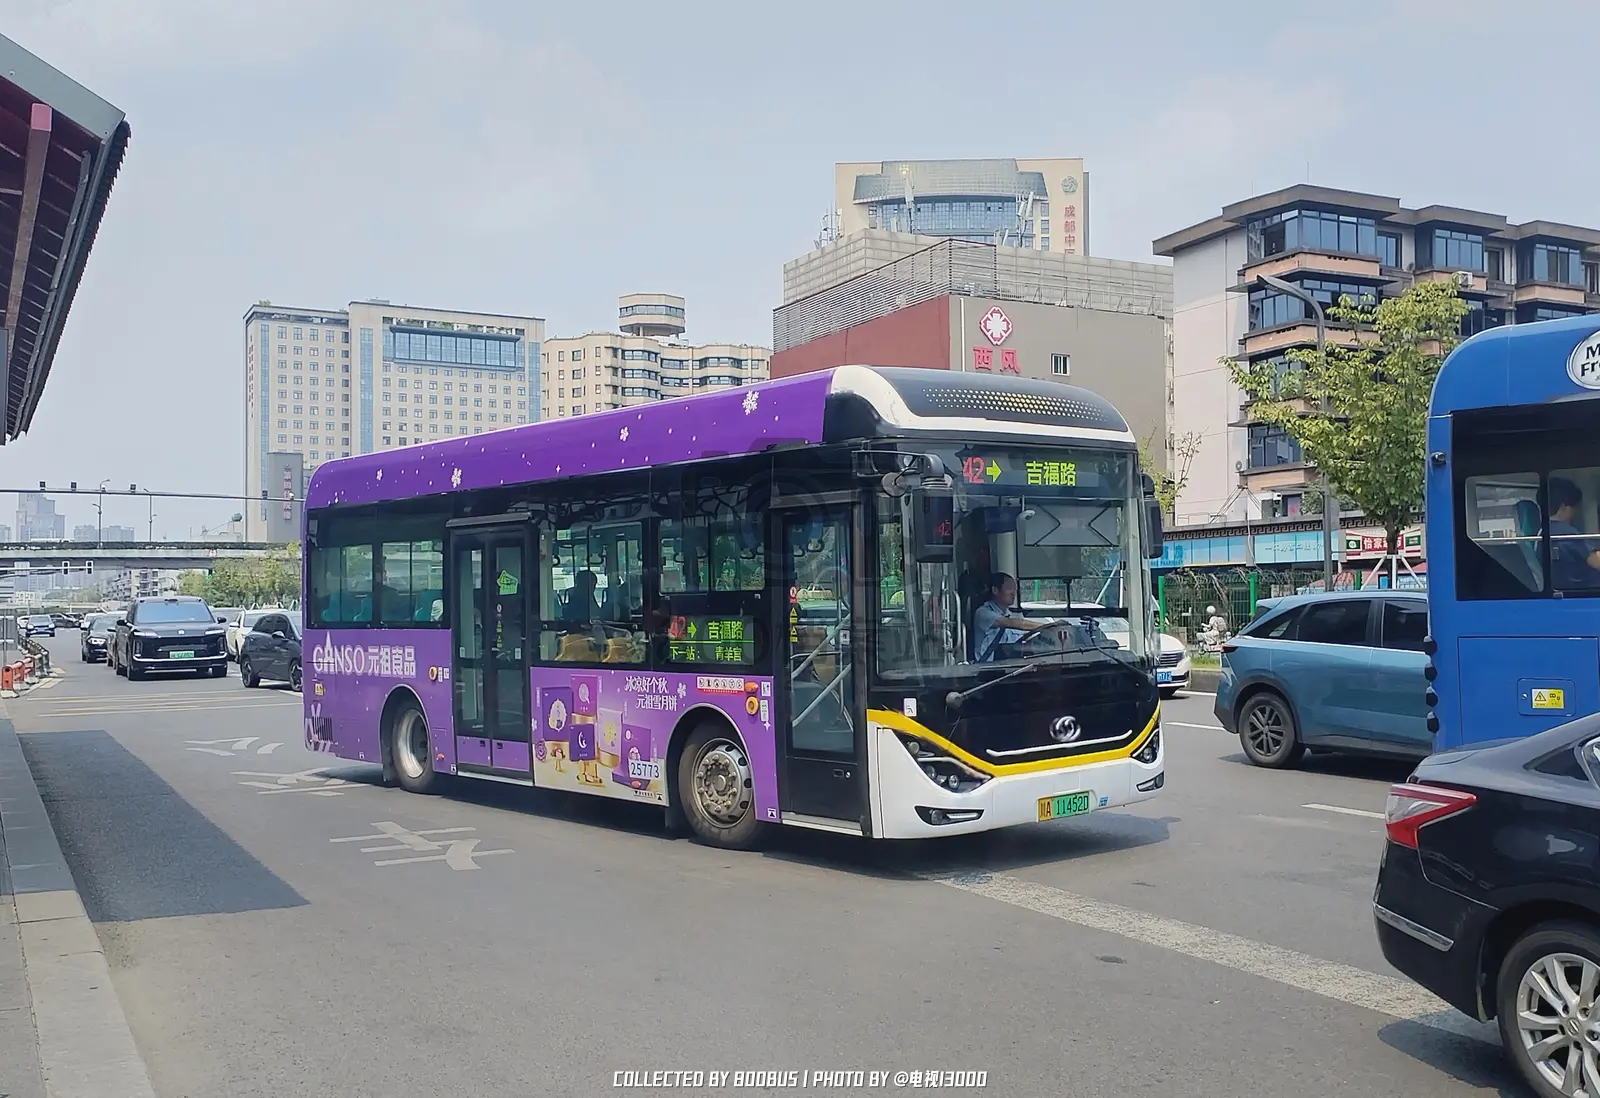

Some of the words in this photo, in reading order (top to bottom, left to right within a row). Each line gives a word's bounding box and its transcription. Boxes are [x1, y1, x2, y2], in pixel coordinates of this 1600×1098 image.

[1581, 360, 1600, 377] Fr
[963, 457, 985, 484] 42
[1025, 461, 1076, 486] 吉福路
[938, 520, 951, 536] 42
[668, 616, 686, 640] 42
[707, 621, 743, 640] 吉福路
[313, 630, 365, 676] GANSO
[368, 646, 416, 678] 元祖食品
[624, 676, 669, 694] 冰凉好个秋
[635, 694, 678, 712] 元祖雪月饼
[631, 762, 660, 779] 25773
